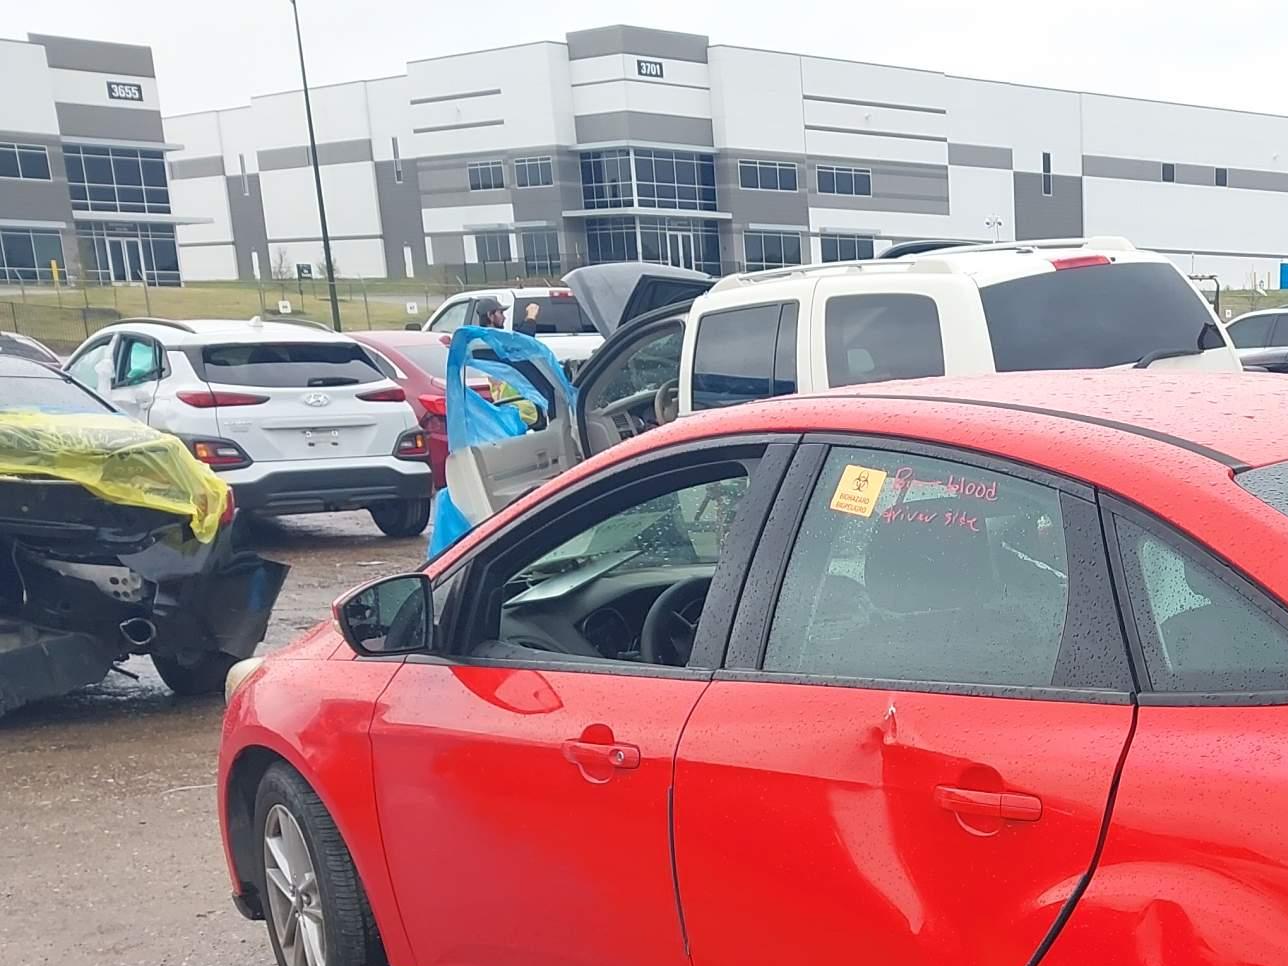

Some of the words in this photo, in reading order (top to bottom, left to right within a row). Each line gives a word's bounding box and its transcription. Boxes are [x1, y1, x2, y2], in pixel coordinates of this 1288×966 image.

[640, 62, 661, 76] 3701
[110, 84, 139, 98] 3655
[945, 474, 998, 501] blood
